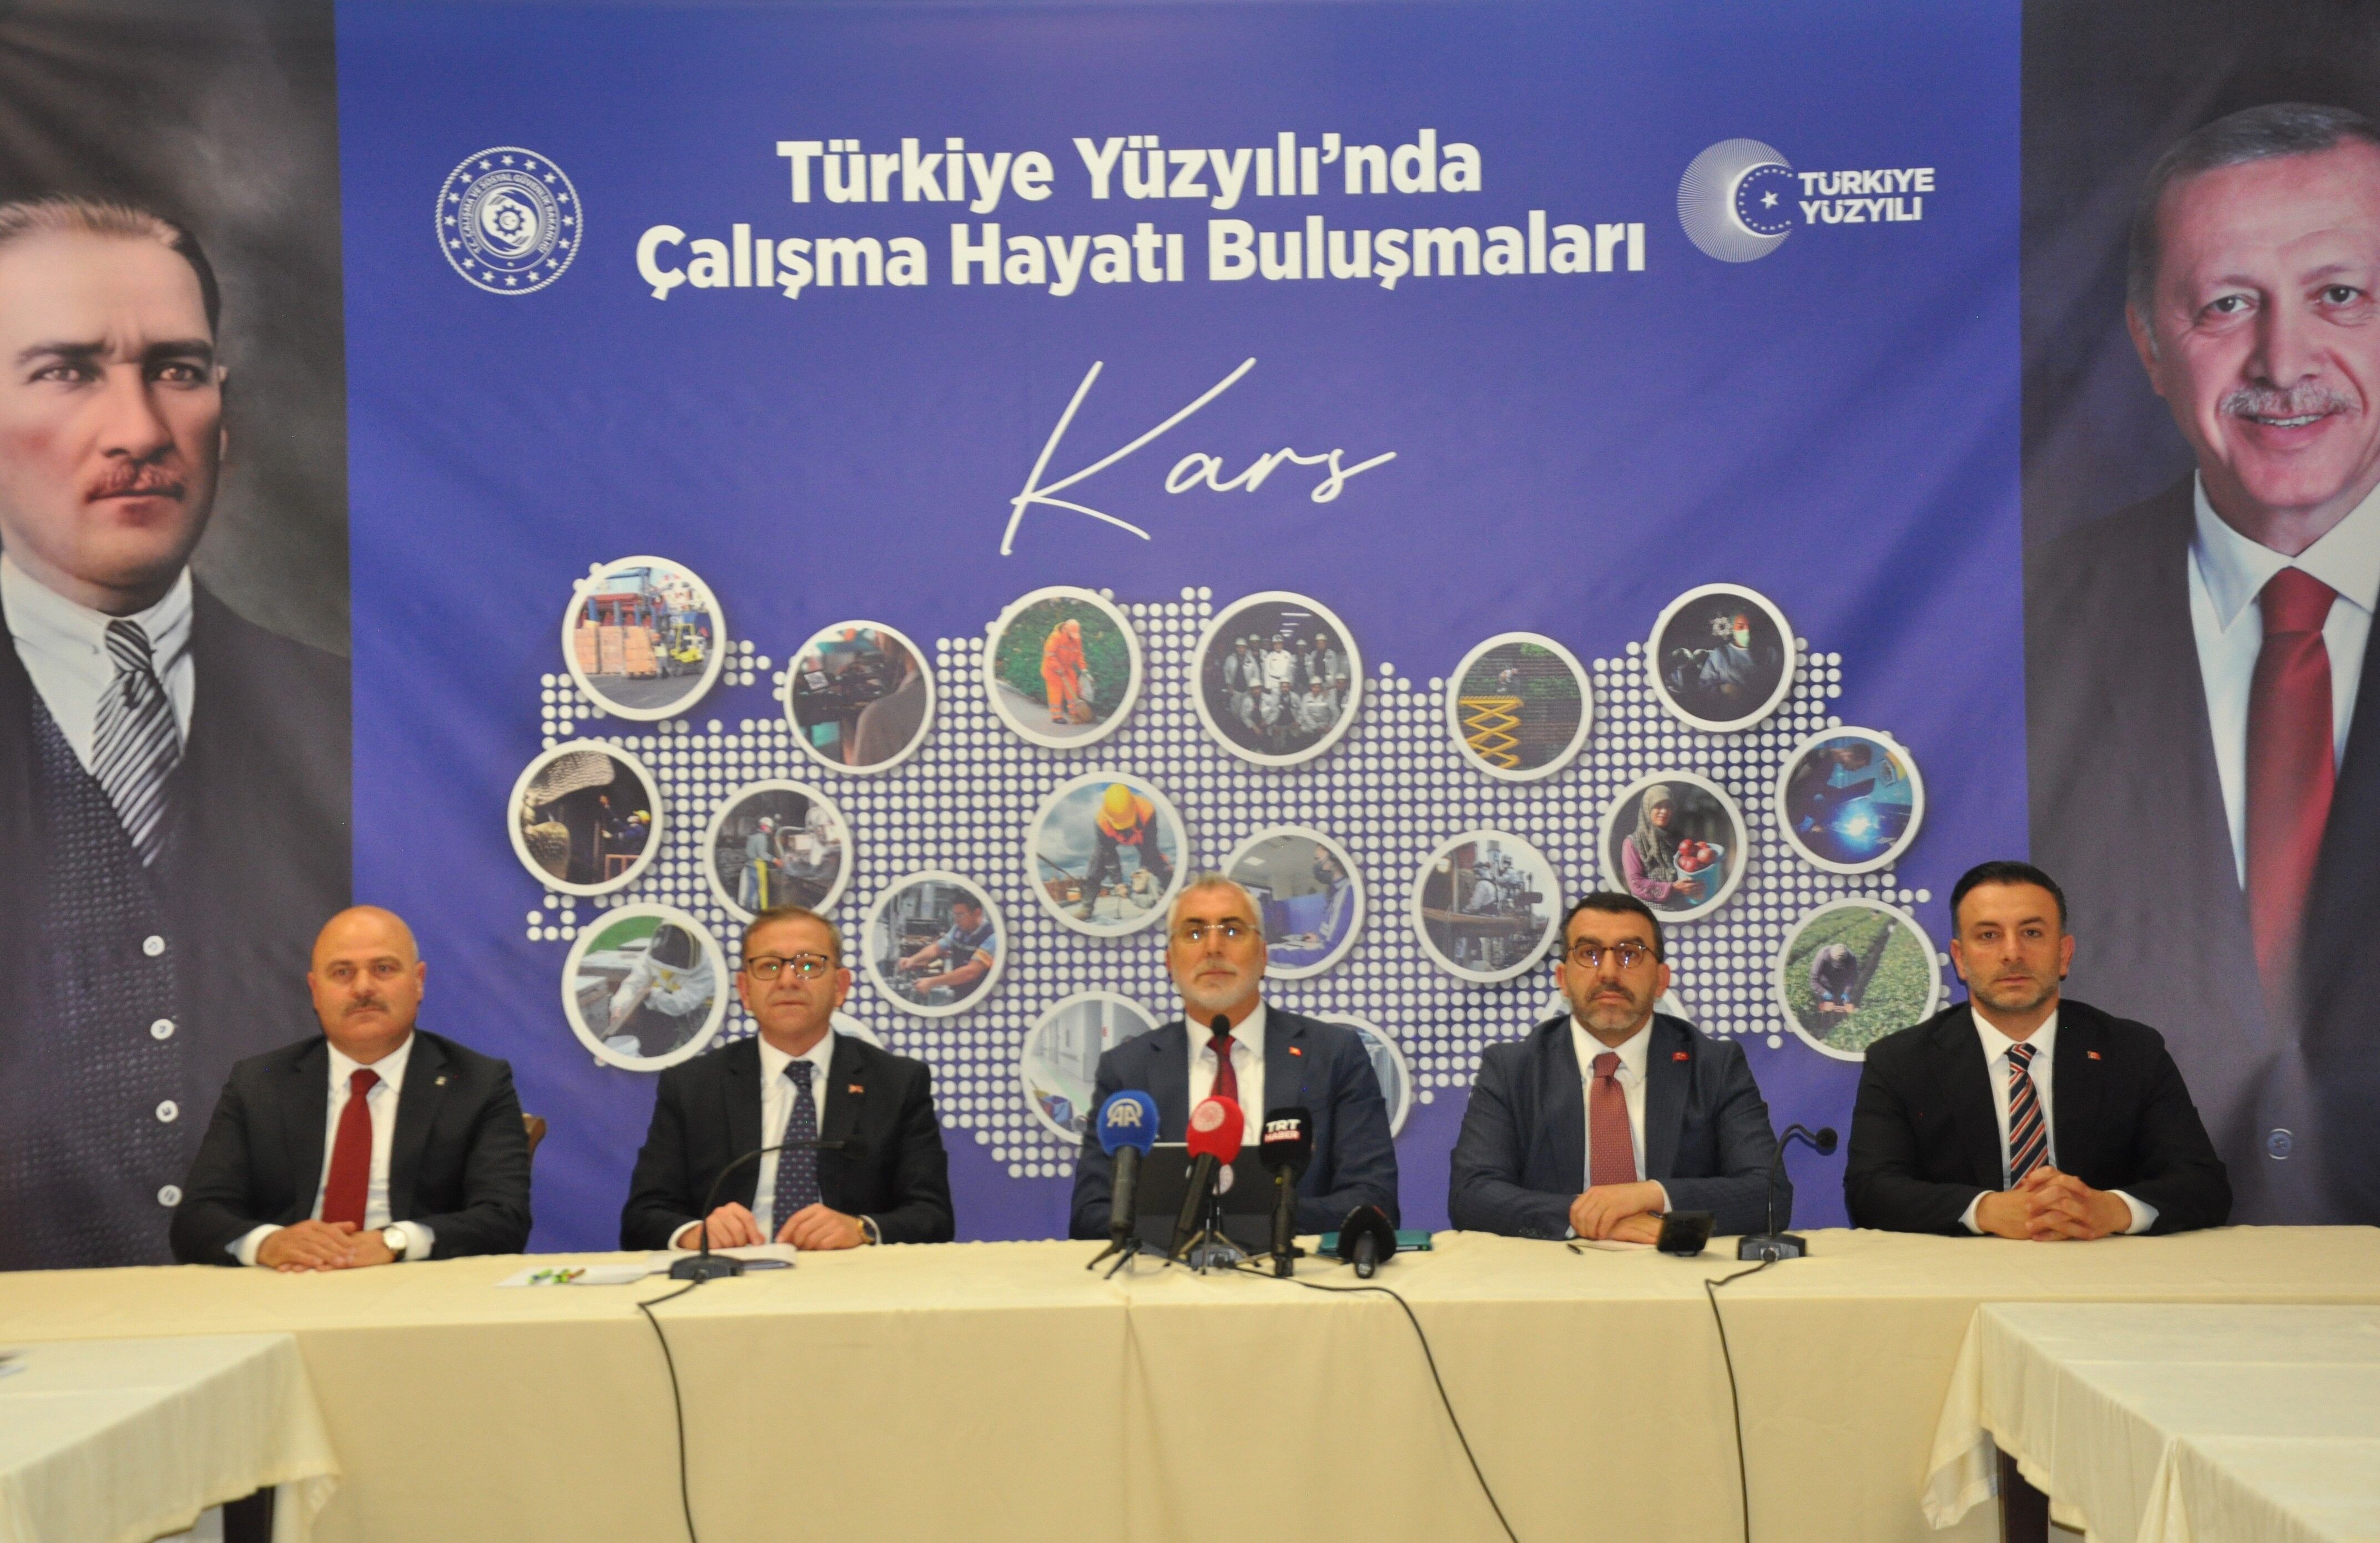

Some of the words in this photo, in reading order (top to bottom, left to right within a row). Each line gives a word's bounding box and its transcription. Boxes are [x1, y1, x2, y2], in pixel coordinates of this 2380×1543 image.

[479, 173, 512, 189] SOSYAL
[776, 137, 1054, 214] Türkiye
[1072, 128, 1481, 211] Yüzyılı’nda
[1798, 168, 1935, 196] TÜRKİYE
[1799, 196, 1922, 225] YÜZYILI
[636, 223, 928, 300] Çalışma
[951, 223, 1184, 296] Hayatı
[1208, 210, 1645, 291] Buluşmaları
[1000, 357, 1397, 556] Kars
[1263, 1130, 1301, 1143] HABER
[1265, 1118, 1302, 1133] TRT
